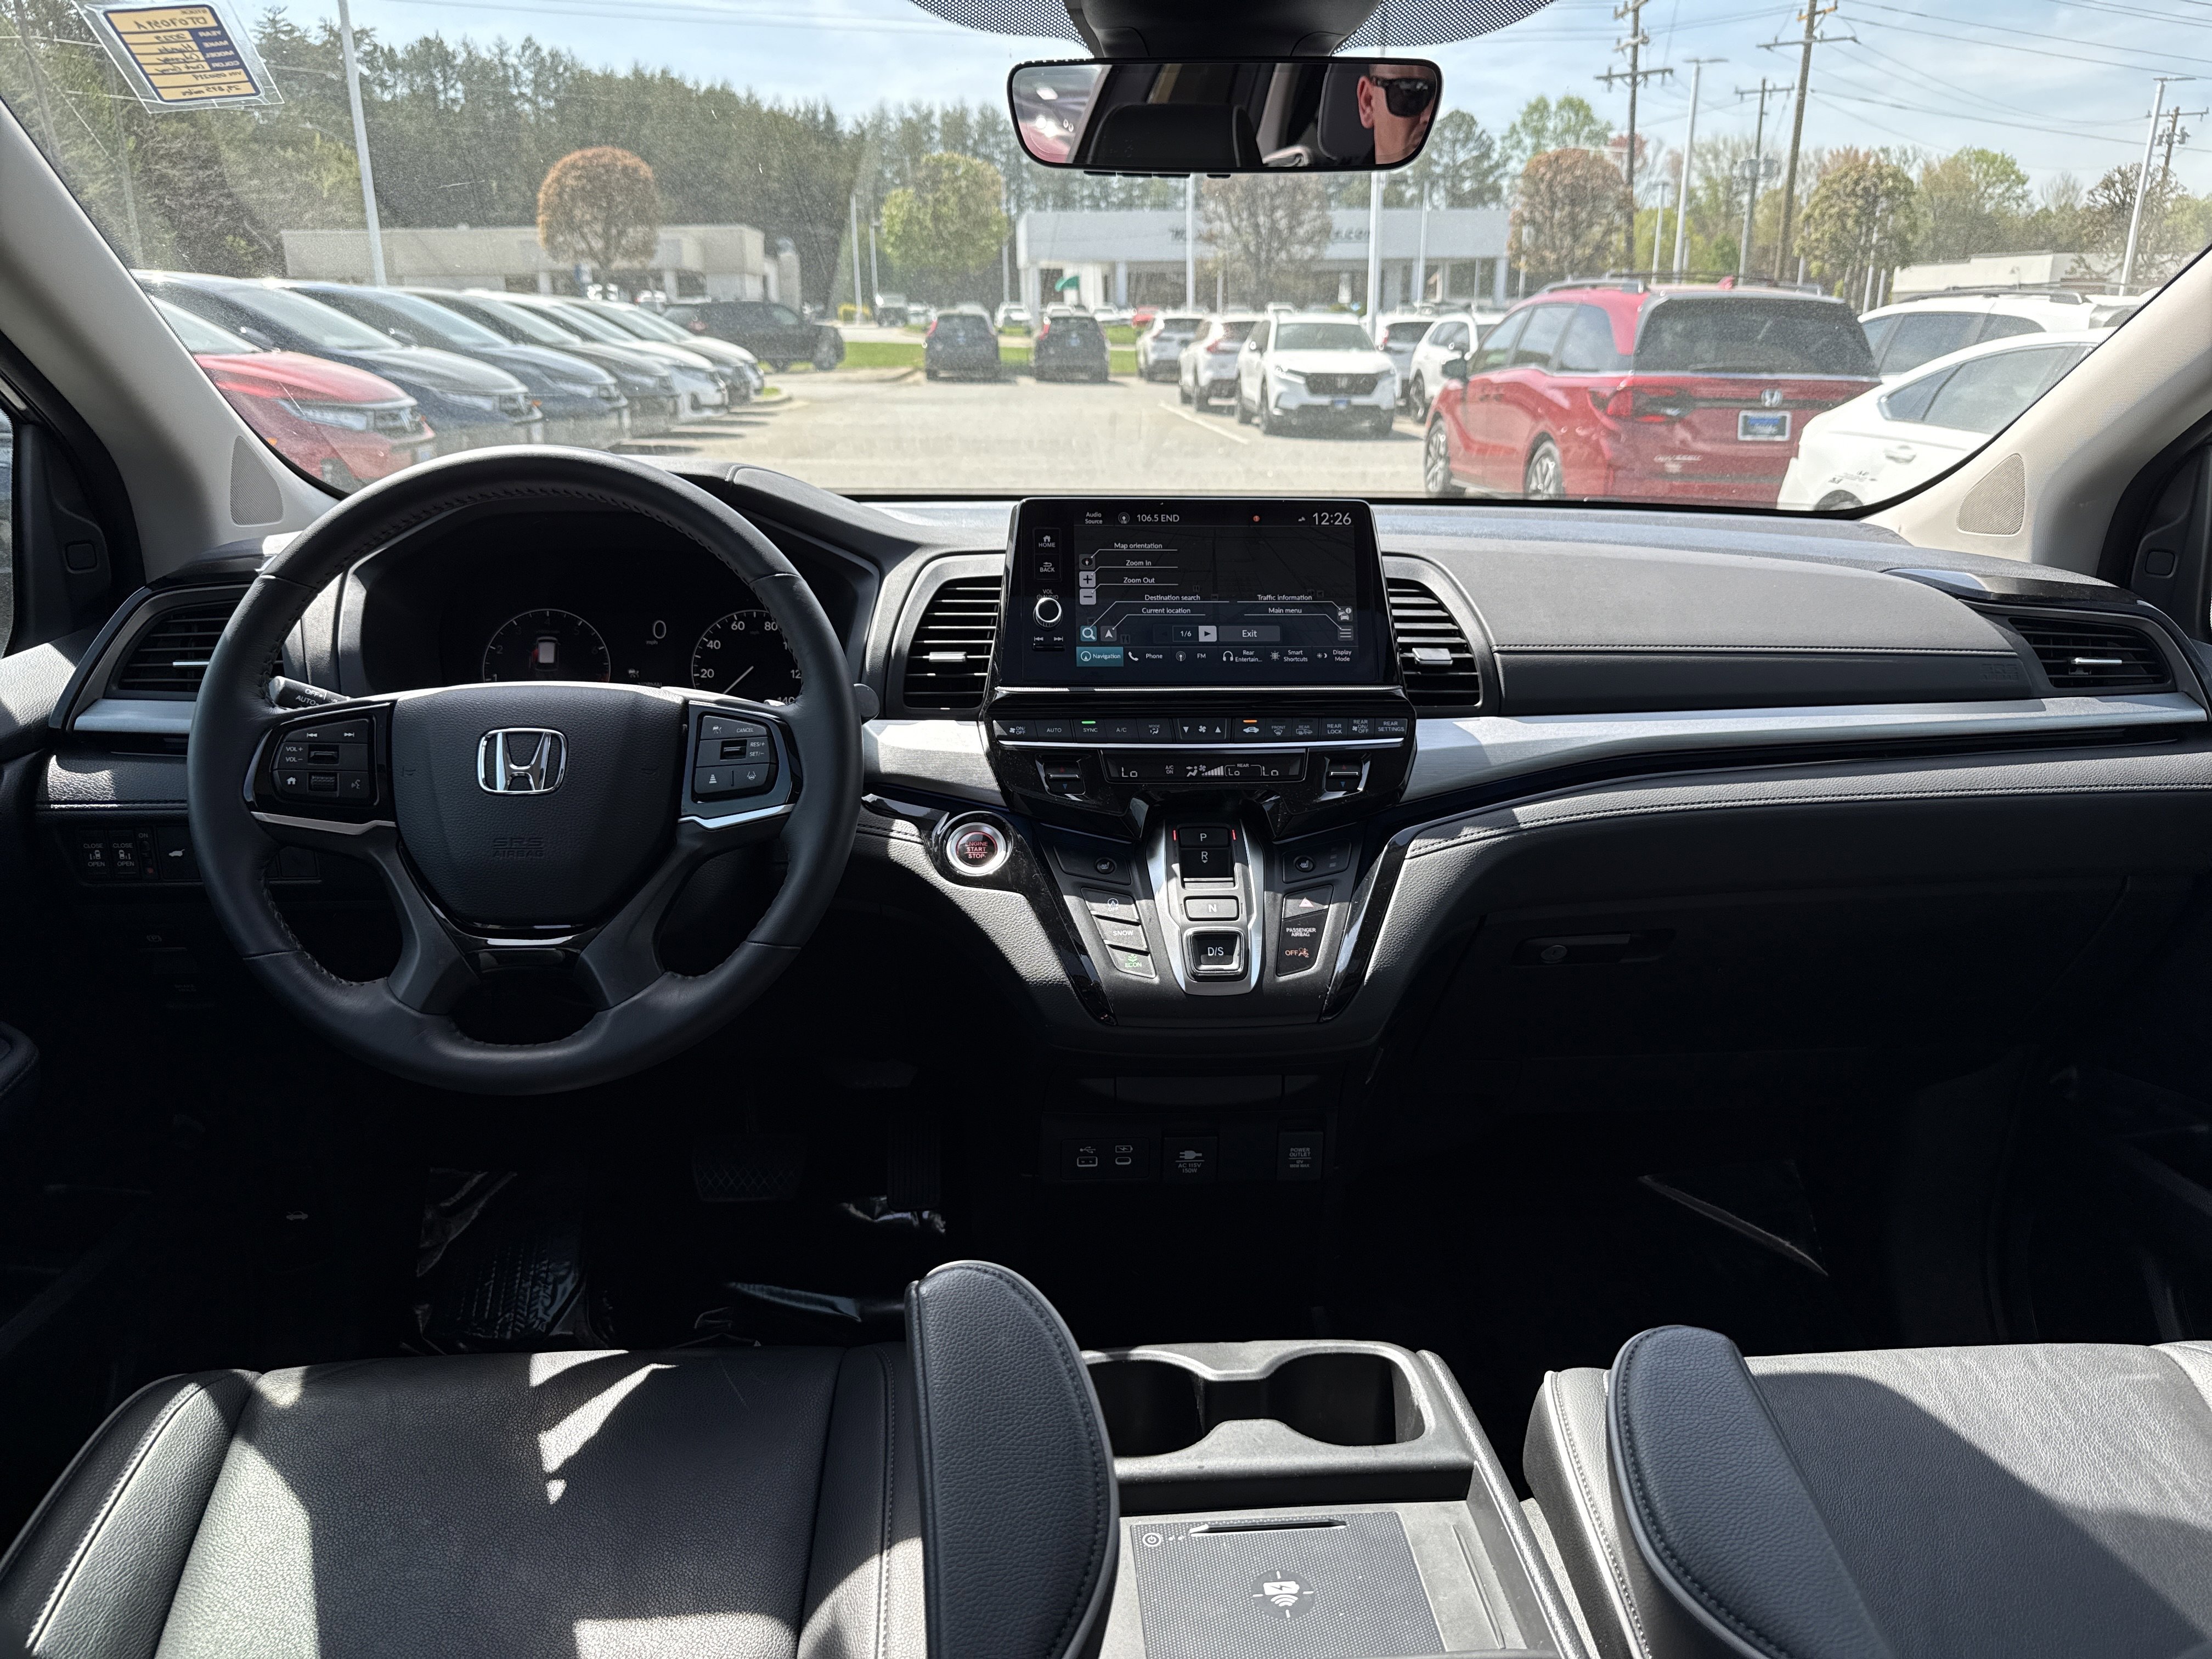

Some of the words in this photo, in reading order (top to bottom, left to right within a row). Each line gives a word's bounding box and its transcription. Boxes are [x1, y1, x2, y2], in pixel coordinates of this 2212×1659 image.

[1312, 512, 1352, 525] 12:26
[652, 619, 667, 639] 0
[731, 621, 745, 631] 60
[764, 621, 778, 631] 80
[706, 640, 721, 650] 40
[700, 668, 714, 678] 20
[790, 669, 802, 679] 12
[305, 689, 320, 697] OFF
[295, 695, 316, 706] AUTO
[1121, 767, 1138, 777] Lo
[1262, 766, 1279, 776] Lo
[1200, 833, 1207, 842] P
[1201, 851, 1208, 860] R
[1208, 904, 1217, 912] N
[1207, 947, 1224, 956] D/S
